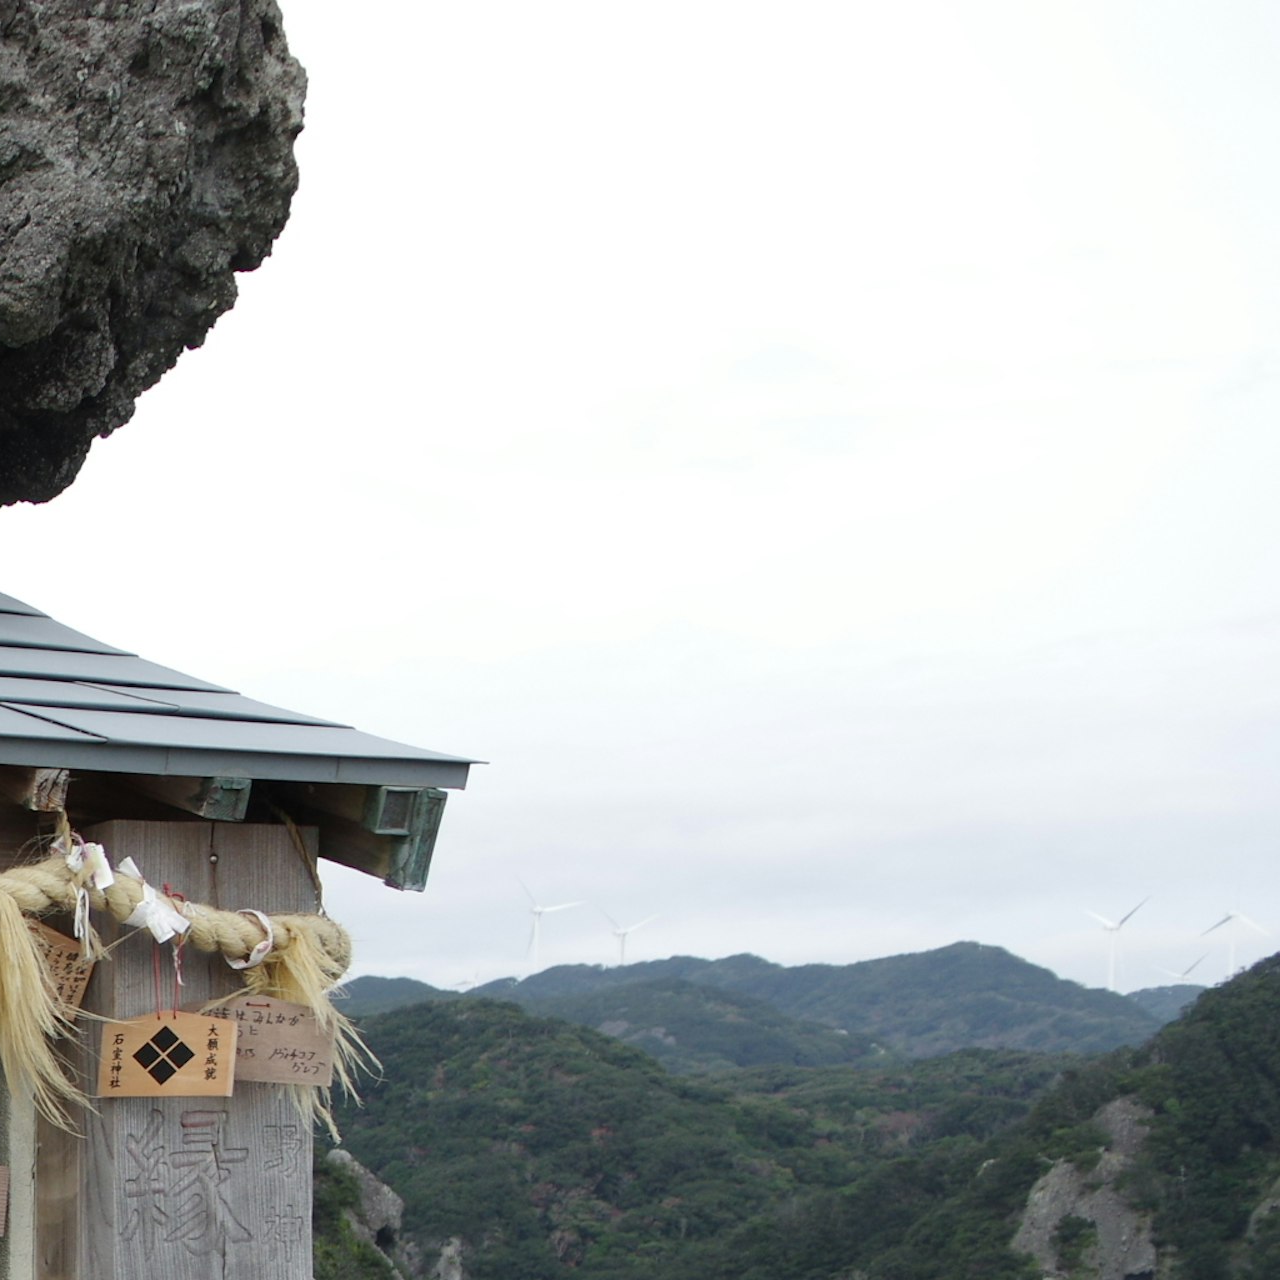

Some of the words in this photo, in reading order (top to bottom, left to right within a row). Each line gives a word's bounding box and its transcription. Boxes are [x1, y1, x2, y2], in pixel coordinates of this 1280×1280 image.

[109, 1033, 124, 1089] 石室神社
[204, 1024, 220, 1081] 大願成就
